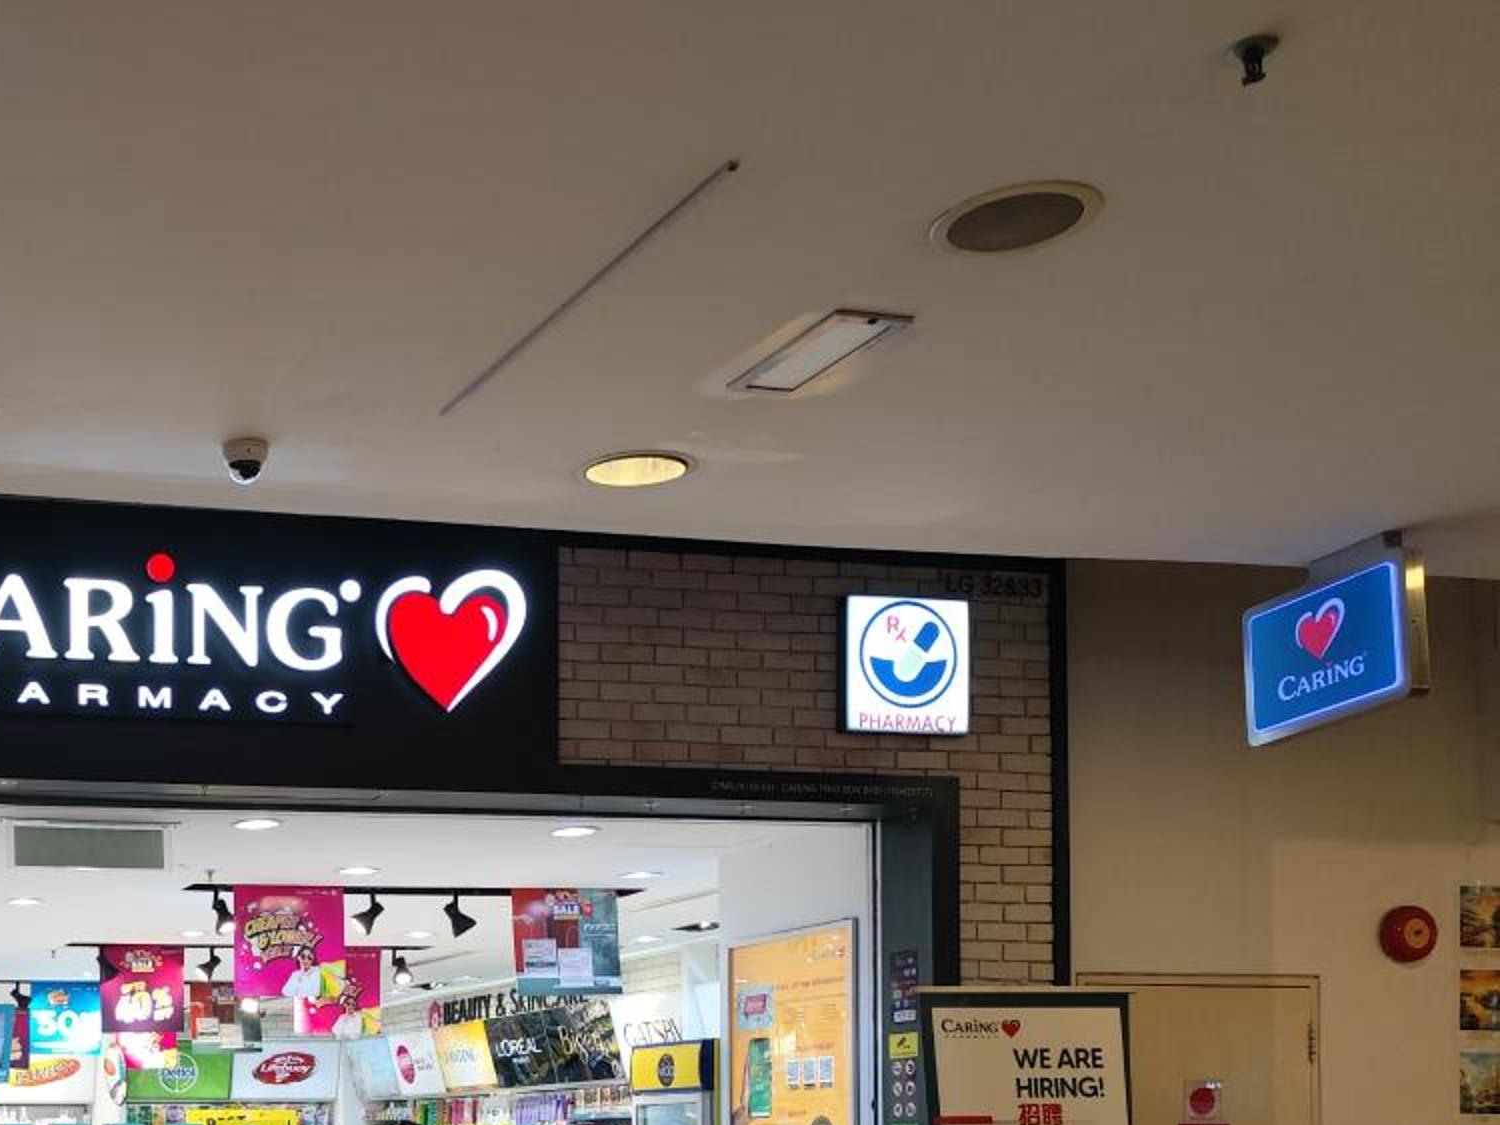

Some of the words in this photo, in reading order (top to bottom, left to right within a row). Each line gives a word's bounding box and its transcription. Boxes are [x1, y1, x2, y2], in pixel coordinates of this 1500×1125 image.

[859, 711, 957, 733] PHARMACY
[1013, 1048, 1052, 1069] WE
[1057, 1048, 1105, 1069] ARE
[1015, 1076, 1106, 1099] HIRING!
